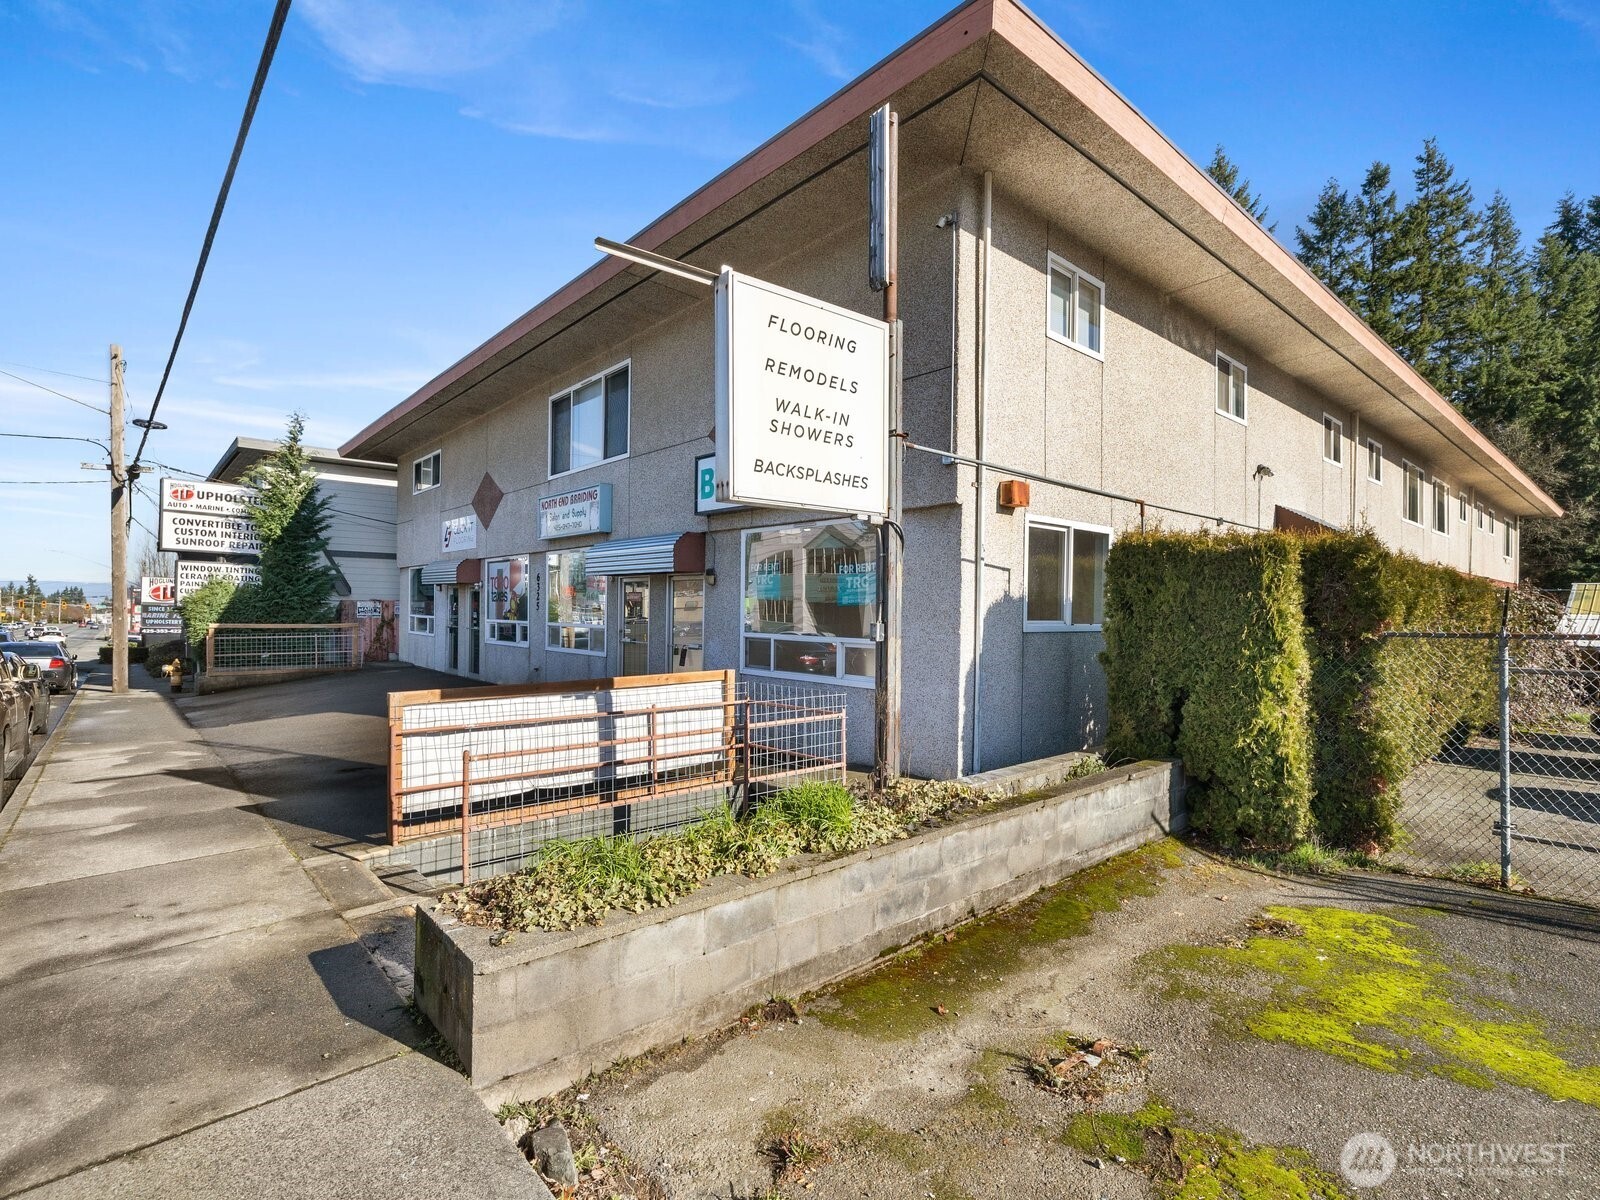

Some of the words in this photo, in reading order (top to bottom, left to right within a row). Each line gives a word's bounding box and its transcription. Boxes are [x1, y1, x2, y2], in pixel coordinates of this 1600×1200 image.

[767, 315, 857, 353] FLOORING
[765, 358, 858, 394] REMODELS
[776, 398, 850, 427] WALK-IN
[769, 419, 854, 448] SHOWERS
[753, 459, 869, 490] BACKSPLASHES
[197, 491, 264, 506] UPHOLSTE
[541, 498, 557, 510] NORTH
[558, 496, 569, 507] END
[570, 489, 598, 505] BRAIDING
[196, 504, 224, 512] MARINE
[571, 507, 587, 518] Supply
[172, 517, 242, 531] CONVERTIBLE
[245, 523, 258, 532] TO
[174, 527, 217, 538] CUSTOM
[220, 531, 260, 541] INTERIO
[175, 537, 226, 547] SUNROOF
[180, 564, 222, 573] WINDOW
[226, 566, 260, 574] TINTING
[839, 565, 855, 574] FOR
[855, 562, 876, 573] RENT
[149, 577, 174, 587] HOGLUN
